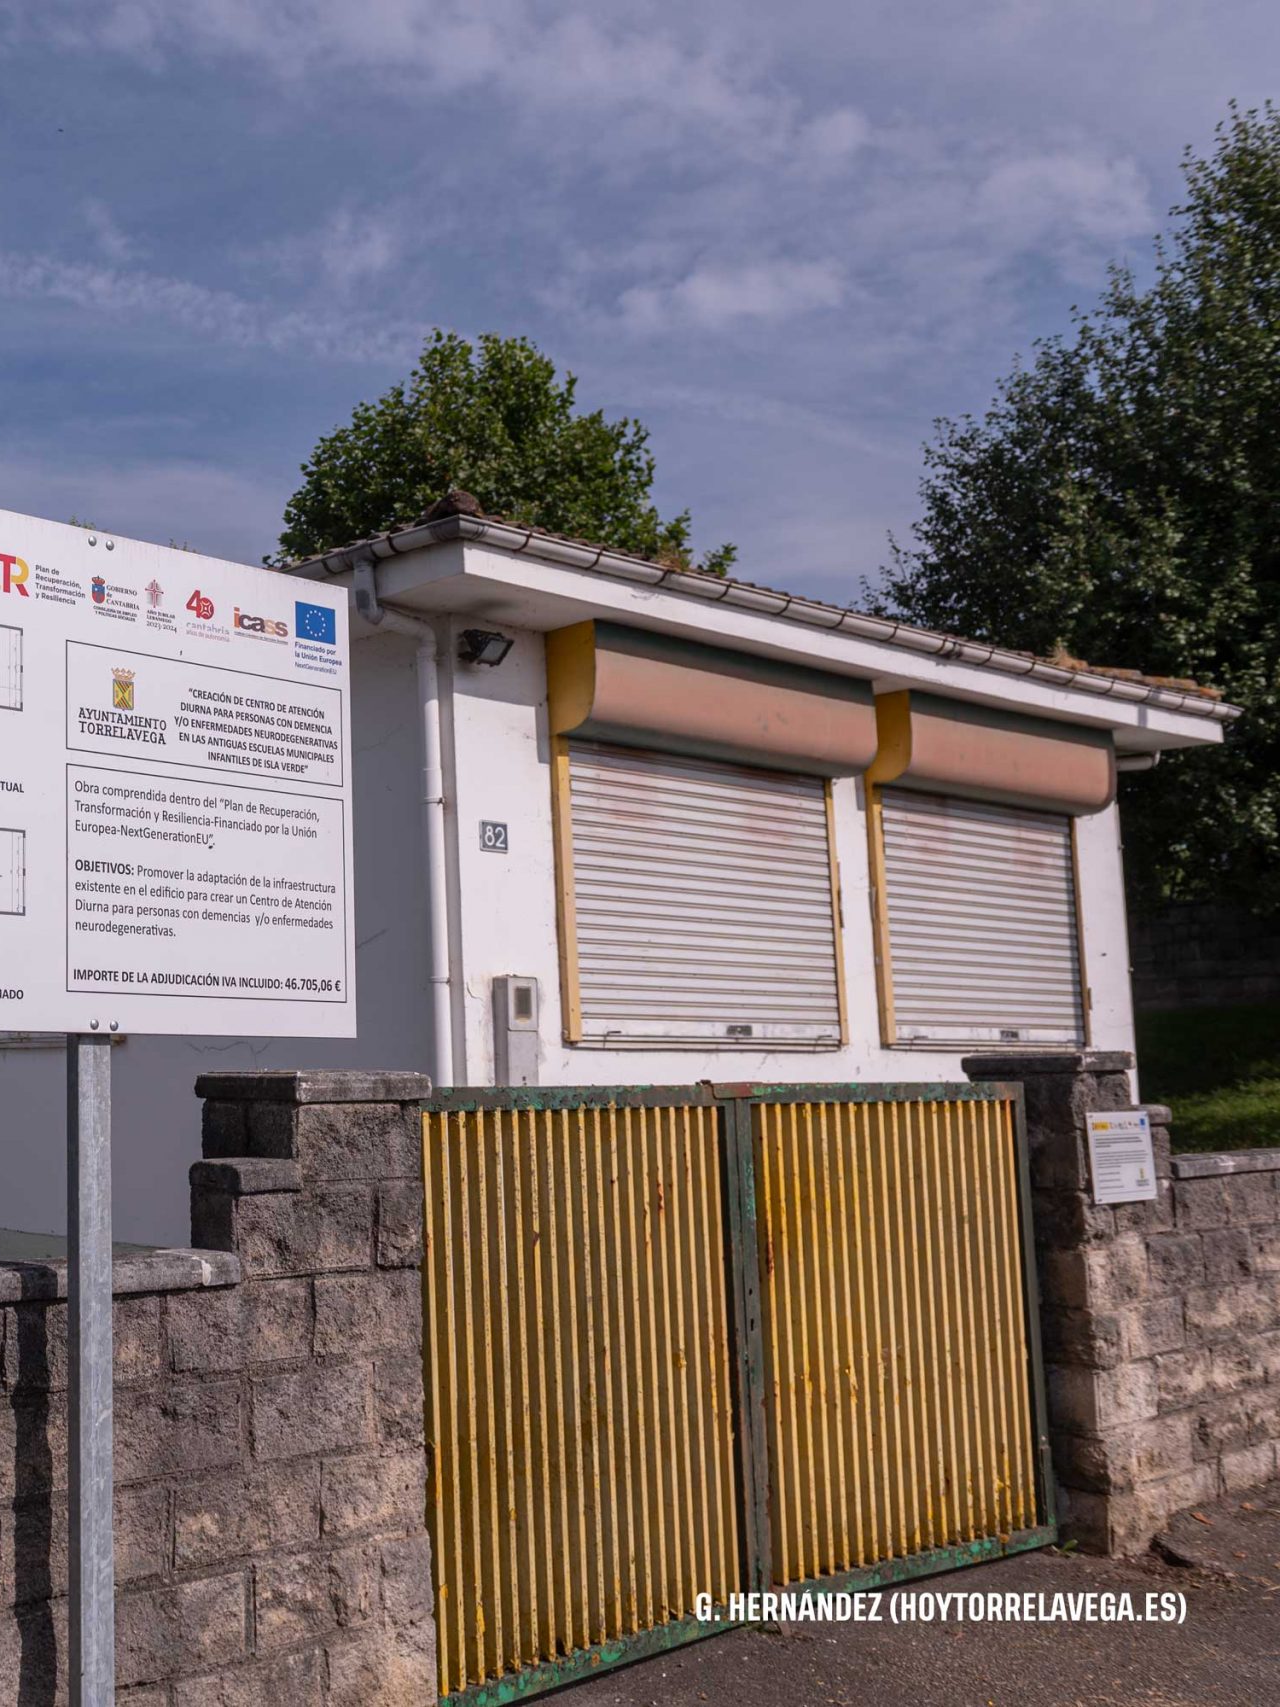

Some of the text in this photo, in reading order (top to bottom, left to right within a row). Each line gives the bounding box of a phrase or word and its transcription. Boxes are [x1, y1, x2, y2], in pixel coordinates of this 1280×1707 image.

[35, 565, 49, 573] Plan
[36, 574, 81, 589] Recuperación,
[36, 583, 85, 598] Transformación
[107, 585, 137, 596] GOBIERNO
[42, 593, 76, 605] Resiliencia
[107, 599, 140, 610] CANTABRIA
[186, 622, 229, 635] cantabria
[234, 607, 288, 637] icass
[295, 641, 325, 653] Financiado
[295, 662, 337, 675] NextGenerationEU
[302, 653, 318, 662] Unión
[319, 656, 342, 666] Europea
[180, 702, 332, 735] DIURNA PARA PERSONAS CON DEMENCIA
[234, 697, 244, 706] DE
[246, 697, 275, 711] CENTRO
[277, 703, 287, 713] DE
[288, 703, 325, 719] ATENCIÓN
[78, 708, 167, 731] AYUNTAMIENTO
[78, 721, 166, 745] TORRELAVEGA
[174, 716, 338, 750] Y/O ENFERMEDADES NEURODEGENERATIVAS
[179, 732, 334, 764] EN LAS ANTIGUAS ESCUELAS MUNICIPALES
[208, 751, 250, 767] INFANTILES
[252, 757, 262, 767] DE
[264, 758, 280, 770] ISLA
[75, 781, 99, 794] Obra
[102, 785, 167, 804] comprendida
[169, 793, 201, 807] dentro
[203, 796, 217, 809] del
[246, 802, 257, 814] de
[259, 804, 320, 823] Recuperación,
[75, 800, 317, 839] Transformación y Resiliencia-Financiado por la Unión
[485, 826, 505, 847] 82
[75, 859, 336, 894] OBJETIVOS: Promover la adaptación de la infraestructura
[75, 882, 332, 911] existente en el edificio para crear un Centro de Atención
[75, 899, 333, 930] Diurna para personas con demencias y/o enfermedades
[75, 920, 176, 937] neurodegenerativas.
[73, 968, 341, 992] IMPORTE DE LA ADJUDICACIÓN IVA INCLUIDO: 46.705,06 €
